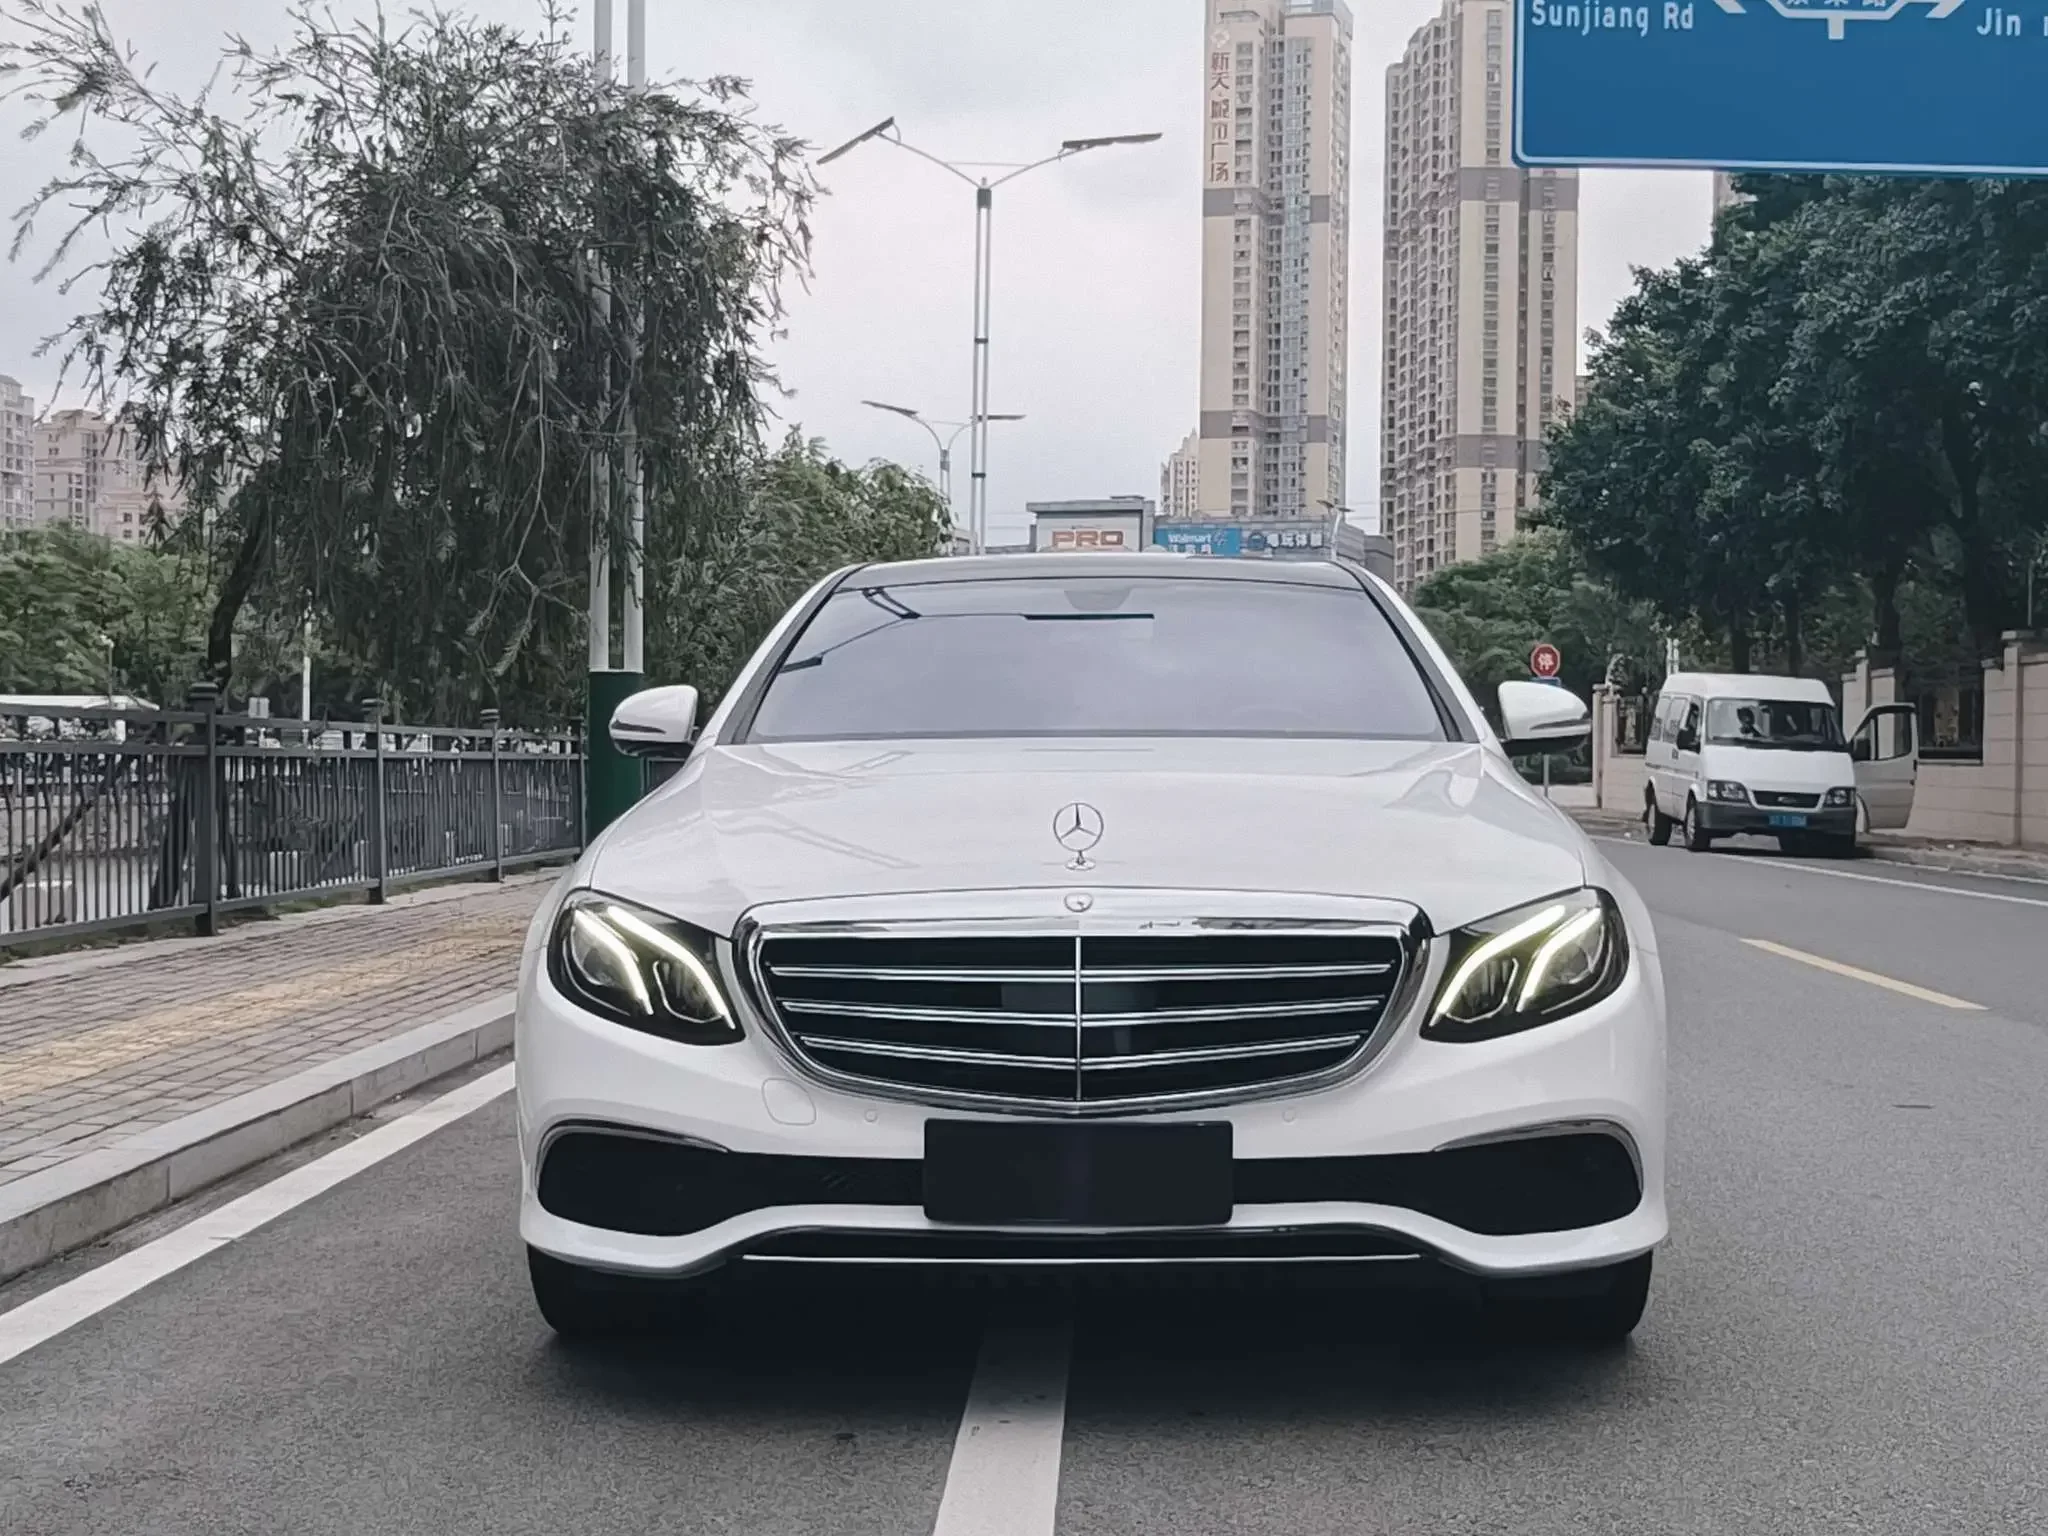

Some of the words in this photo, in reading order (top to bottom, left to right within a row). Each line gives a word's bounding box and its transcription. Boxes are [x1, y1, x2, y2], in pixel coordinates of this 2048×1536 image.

[1531, 0, 1649, 36] Sunjiang
[1664, 2, 1694, 29] Rd
[1976, 7, 2021, 36] Jin
[1052, 530, 1124, 547] PRO
[1168, 533, 1212, 543] Walmart
